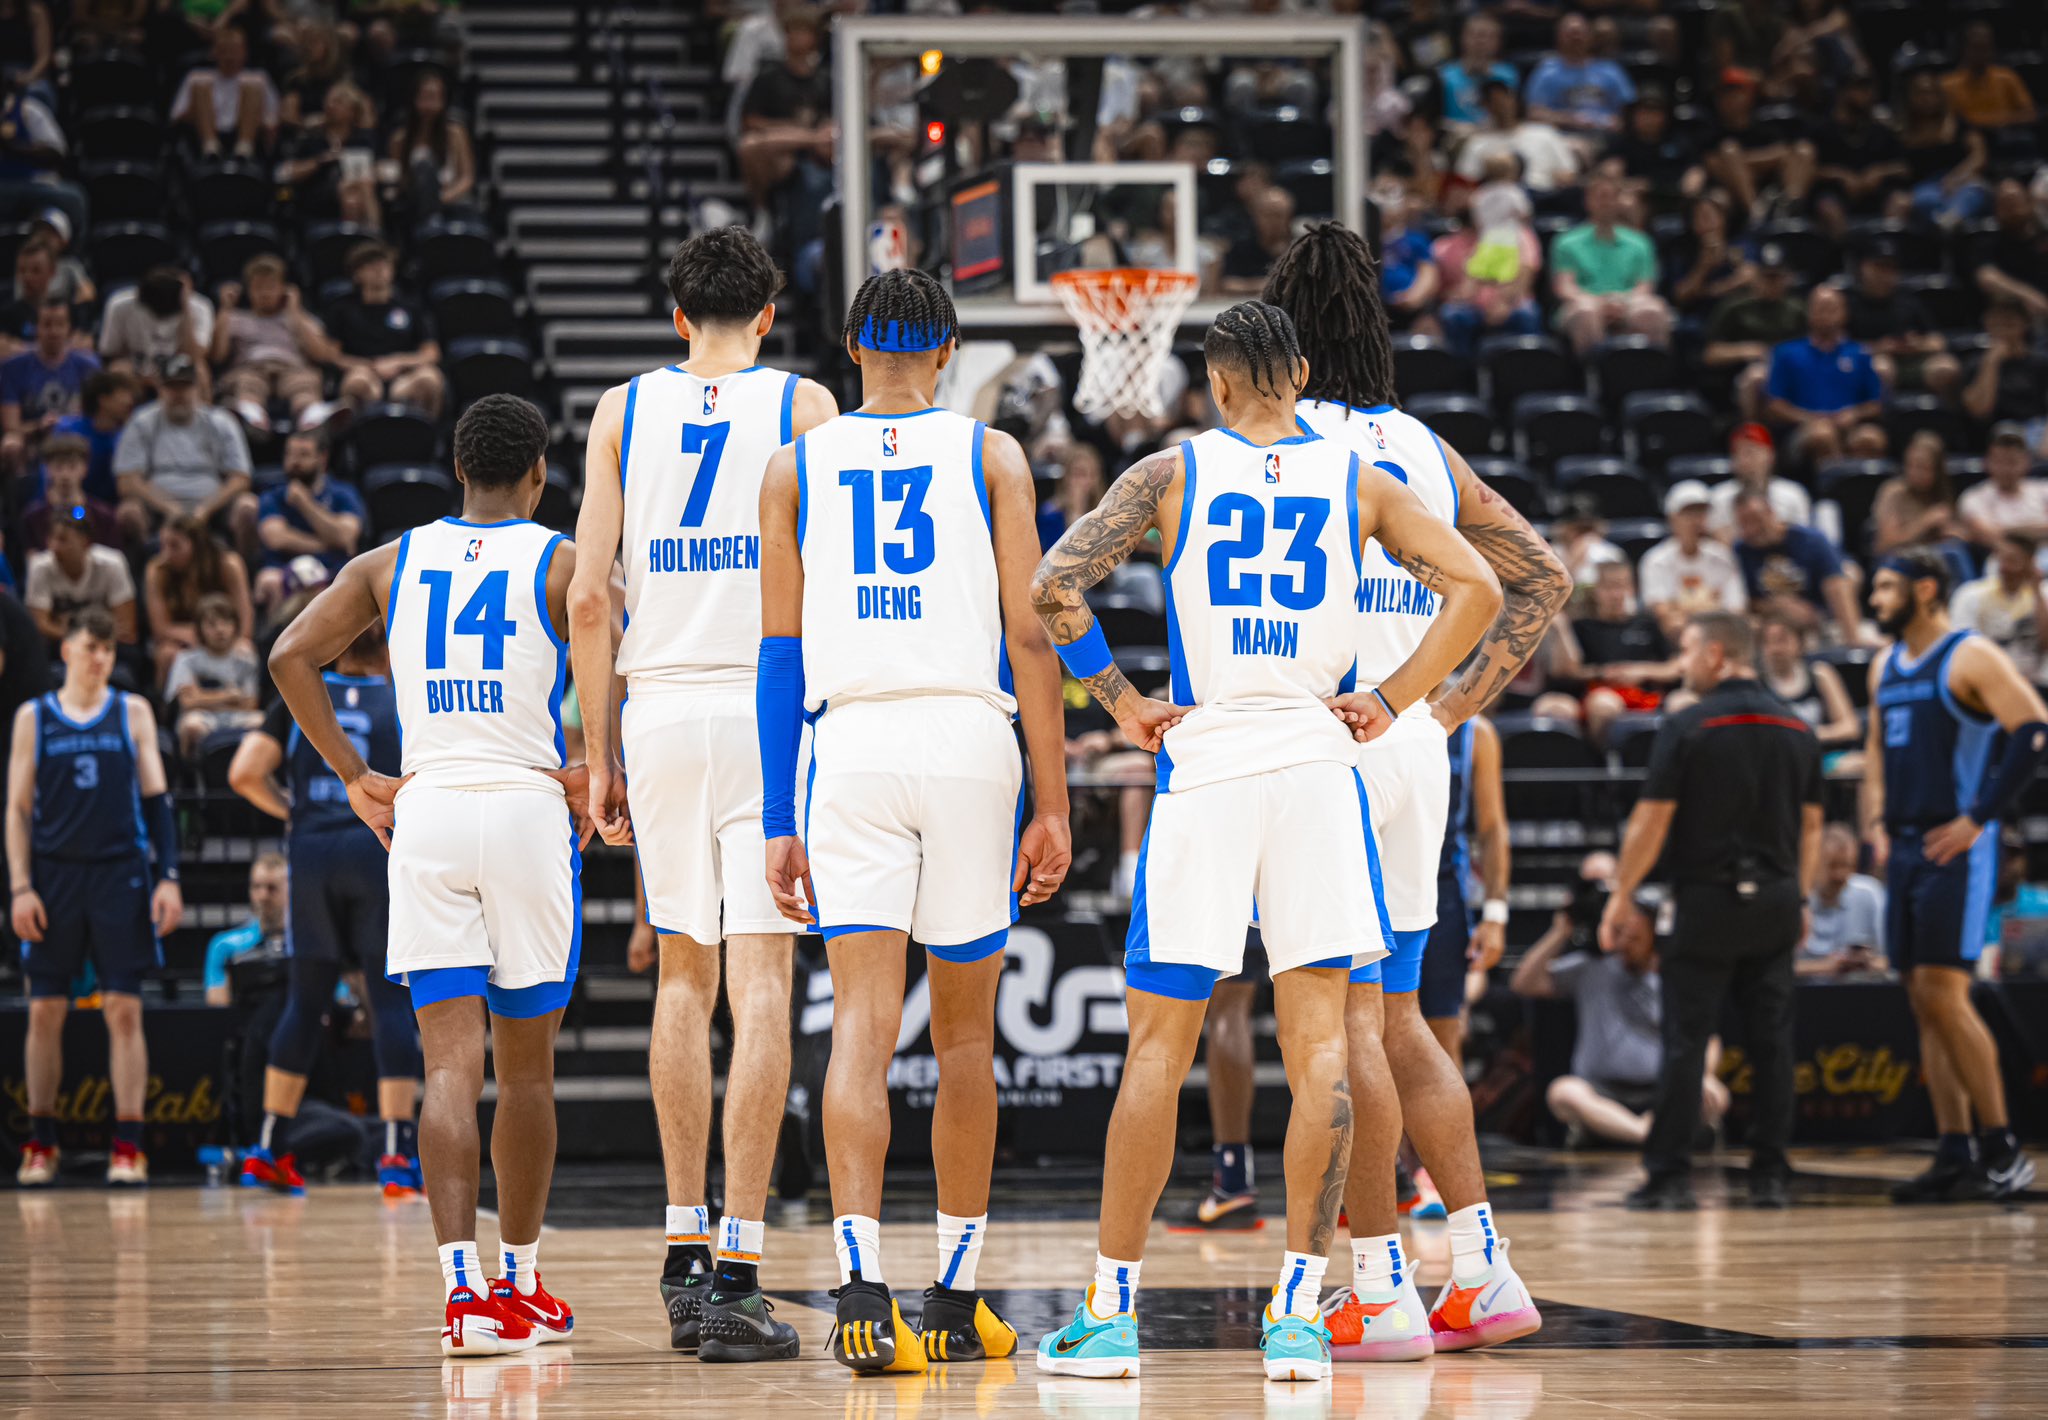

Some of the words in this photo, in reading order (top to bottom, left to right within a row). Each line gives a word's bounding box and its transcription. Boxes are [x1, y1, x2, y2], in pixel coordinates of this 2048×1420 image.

[678, 420, 731, 528] 7
[838, 465, 936, 575] 13
[649, 535, 759, 572] HOLMGREN
[1207, 492, 1331, 611] 23
[857, 585, 922, 621] DIENG
[1354, 577, 1436, 617] WILLIAMS
[418, 569, 517, 671] 14
[1232, 617, 1299, 659] MANN
[426, 679, 505, 714] BUTLER
[74, 754, 98, 790] 3
[1013, 1053, 1124, 1089] FIRST
[1815, 1044, 1909, 1103] City
